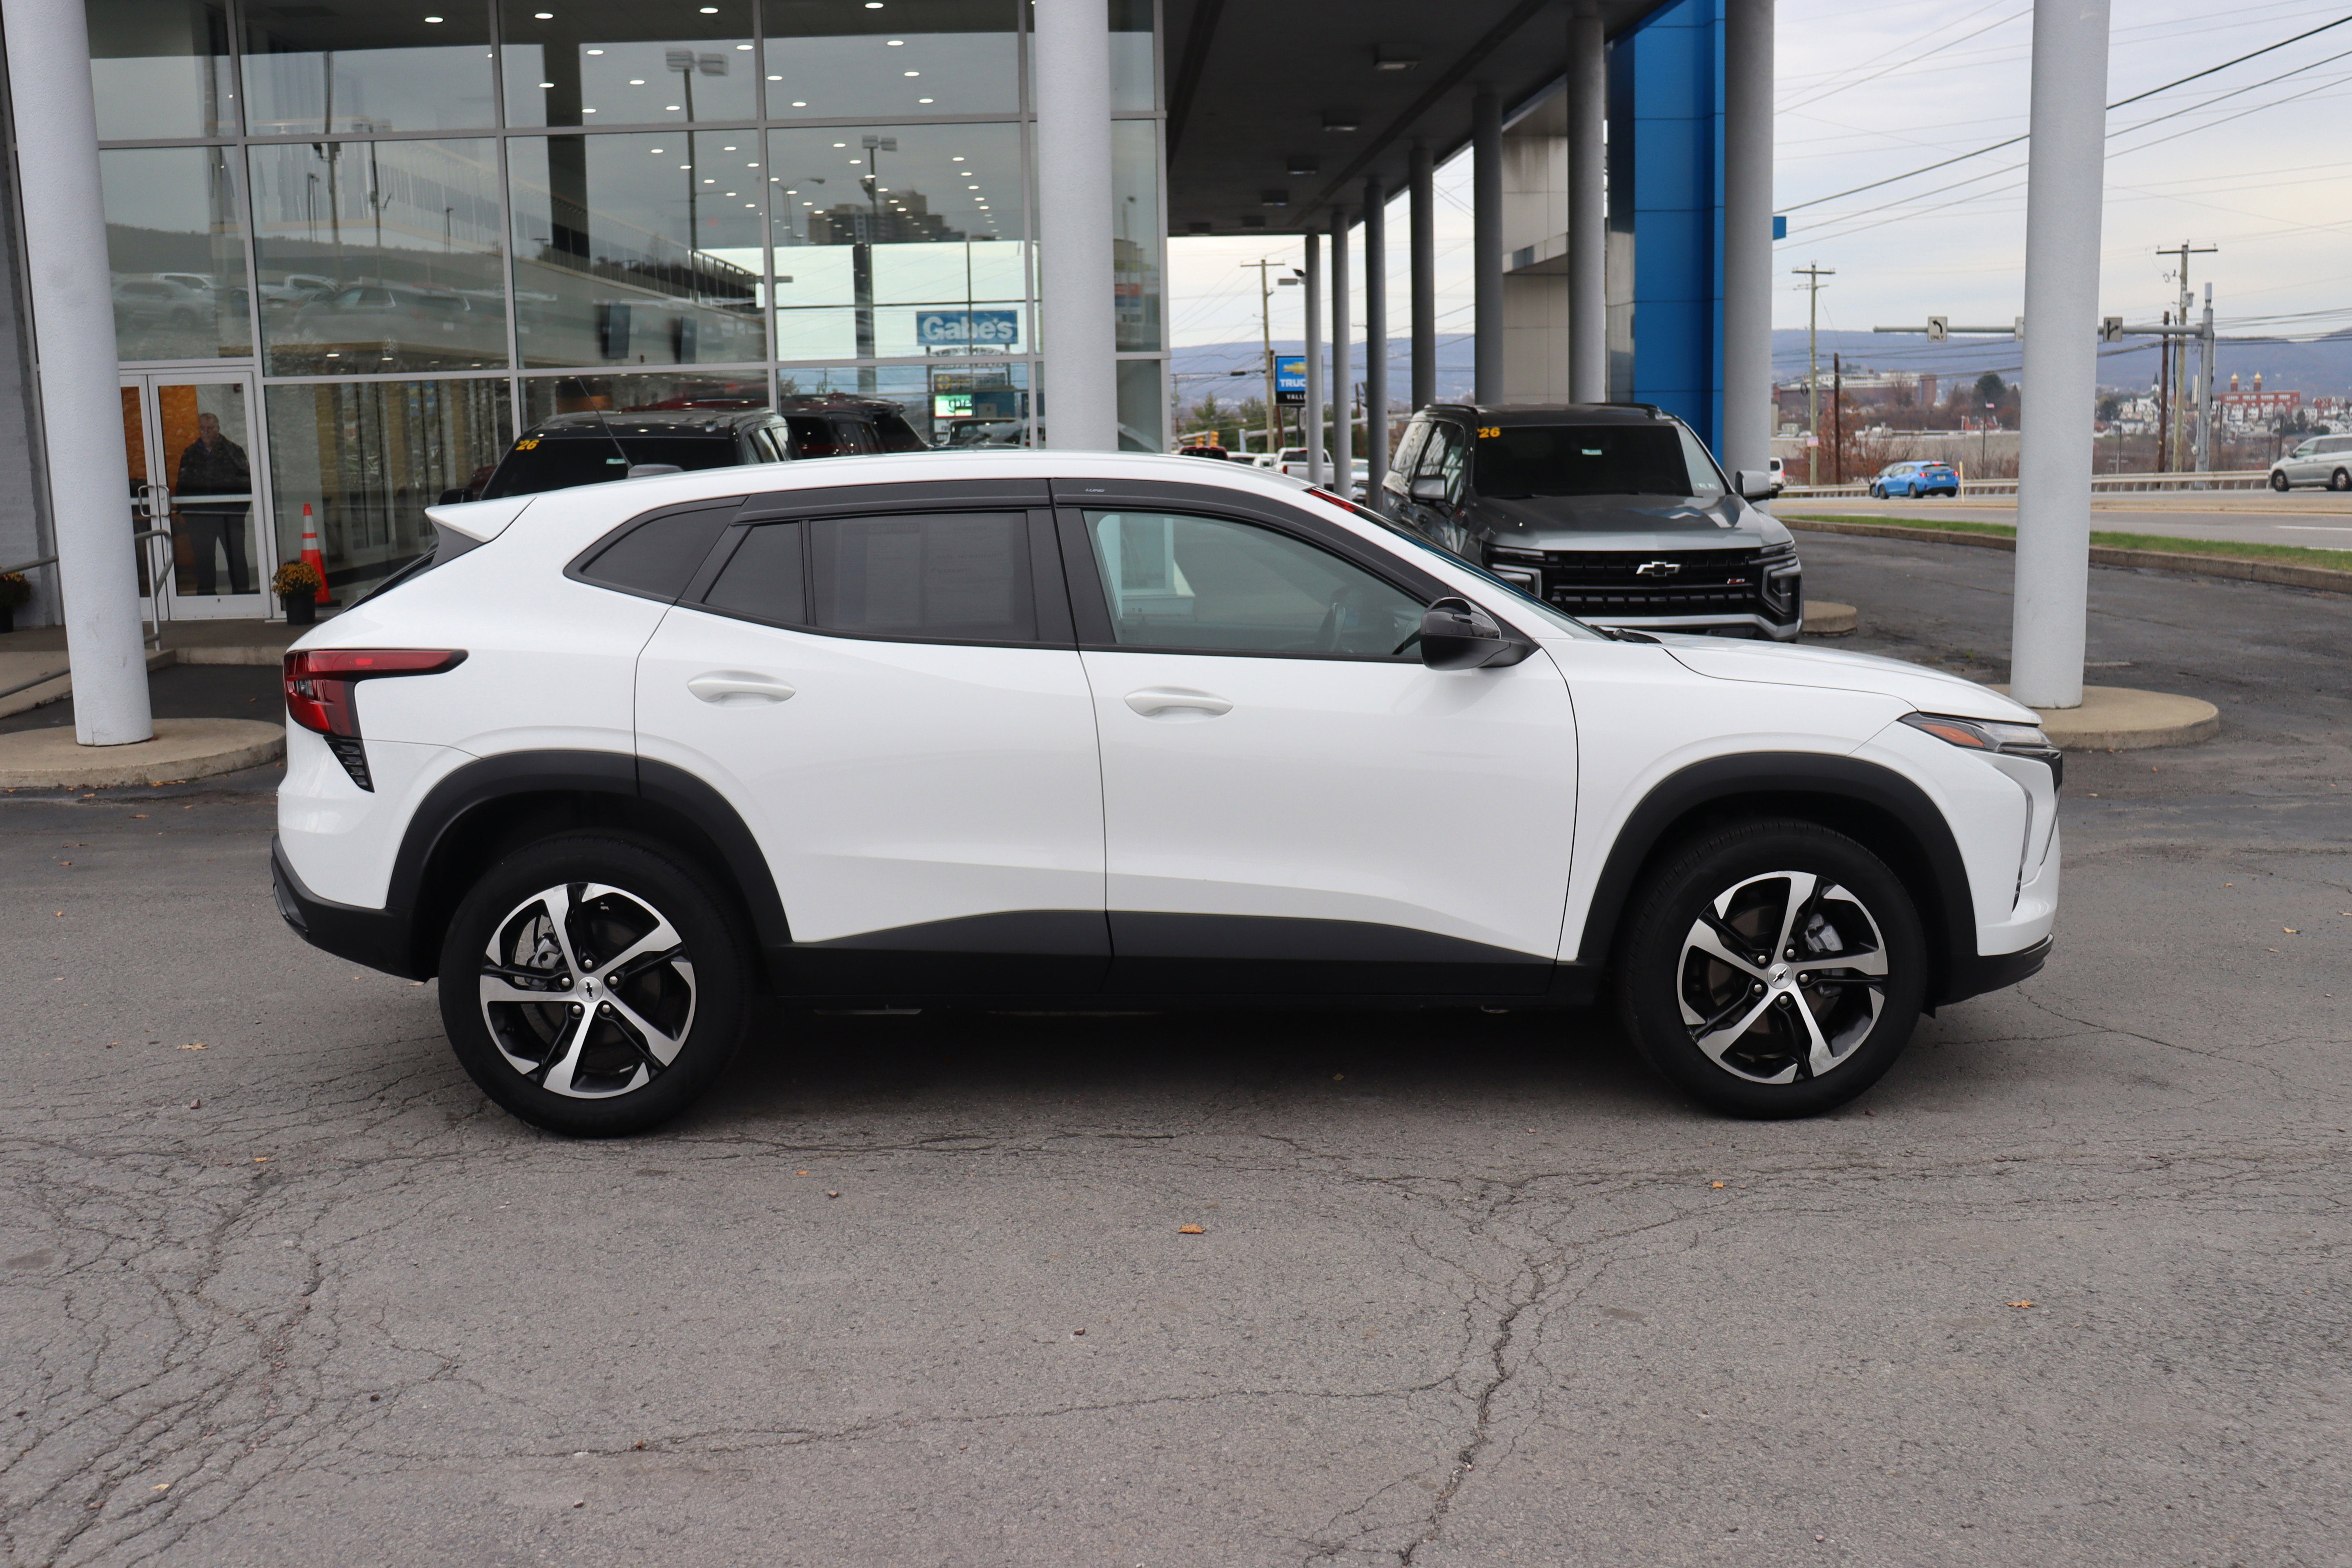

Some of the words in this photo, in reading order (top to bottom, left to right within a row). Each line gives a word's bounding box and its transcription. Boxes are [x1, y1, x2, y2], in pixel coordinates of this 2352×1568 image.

[923, 316, 1013, 340] Gabe's
[1279, 379, 1306, 387] TRUC
[869, 524, 917, 532] CERTIFIED
